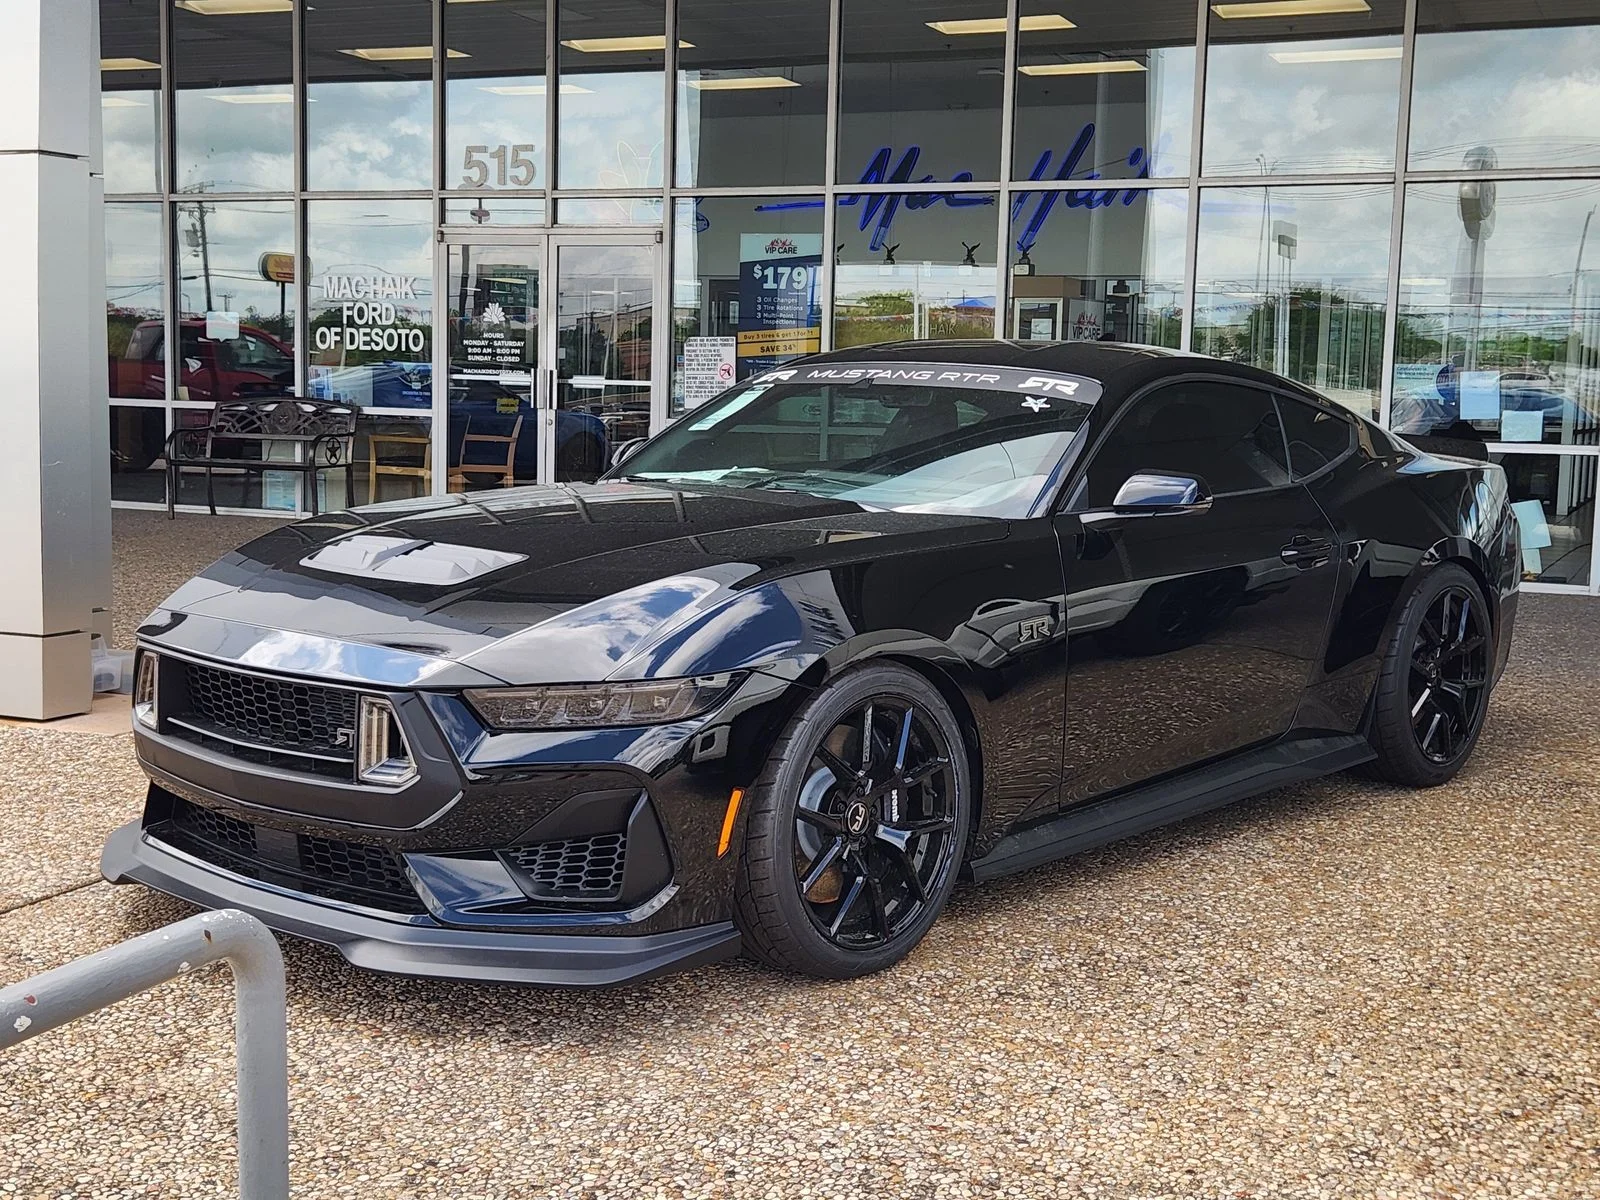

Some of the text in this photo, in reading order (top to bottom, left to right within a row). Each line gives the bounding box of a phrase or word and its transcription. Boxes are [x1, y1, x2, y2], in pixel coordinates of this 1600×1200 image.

[463, 145, 536, 187] 515
[323, 276, 418, 299] MAC HAIK
[342, 302, 396, 325] FORD
[316, 327, 424, 352] OF DESOTO
[760, 345, 781, 353] SAVE
[807, 369, 1001, 384] MUSTANG RTR
